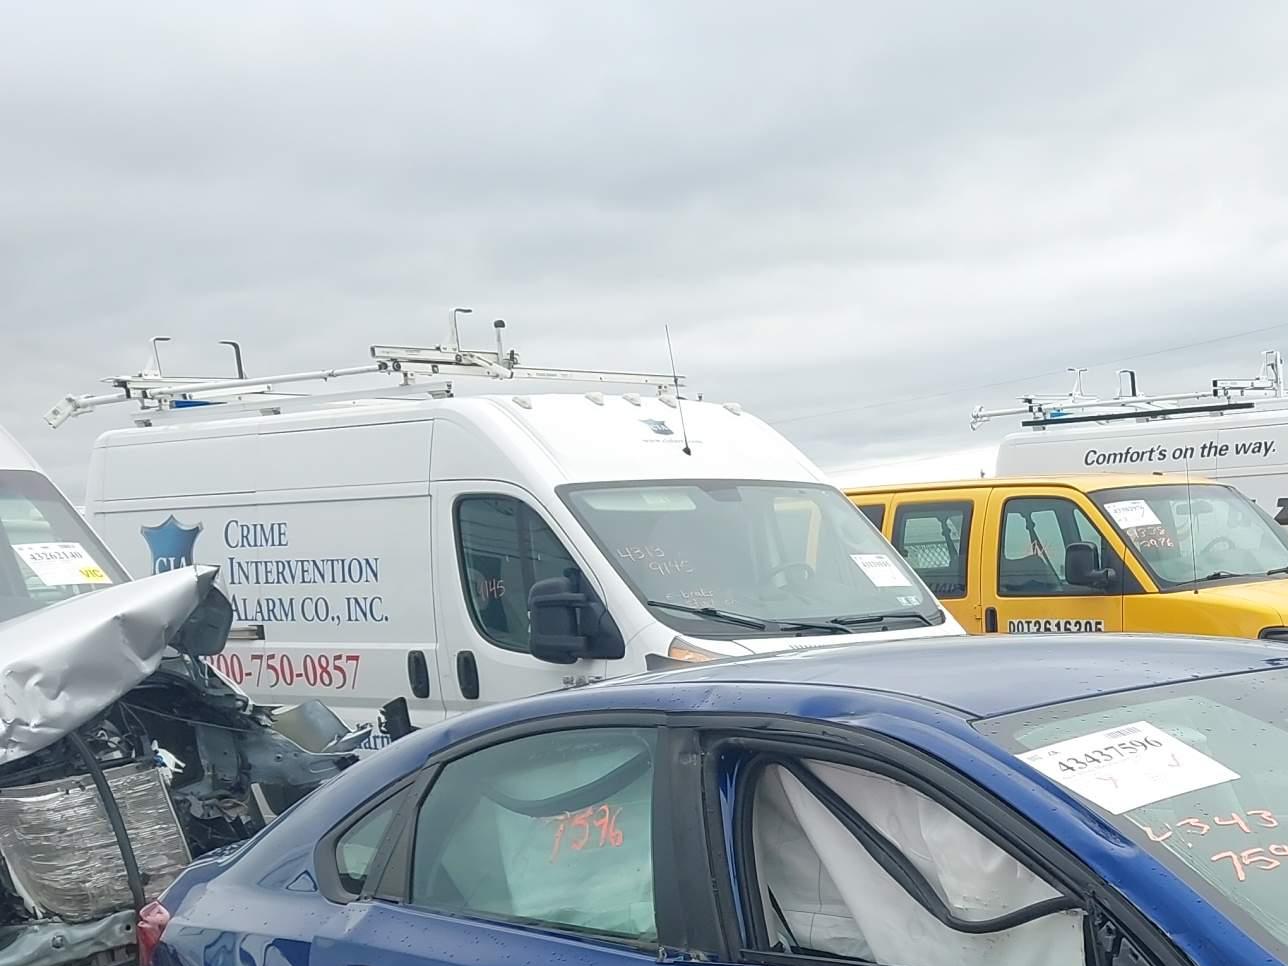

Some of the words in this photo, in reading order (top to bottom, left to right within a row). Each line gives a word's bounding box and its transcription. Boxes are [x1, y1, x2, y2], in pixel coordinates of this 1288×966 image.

[1084, 445, 1167, 466] Comfort's
[1172, 446, 1194, 460] on
[1200, 441, 1229, 458] the
[1234, 440, 1277, 458] way.
[224, 519, 288, 549] CRIME
[79, 569, 104, 578] VIC
[229, 557, 380, 585] INTERVENTION
[232, 593, 296, 622] ALARM
[301, 596, 341, 626] CO.,
[346, 596, 390, 622] INC.
[1058, 735, 1163, 773] 43437596
